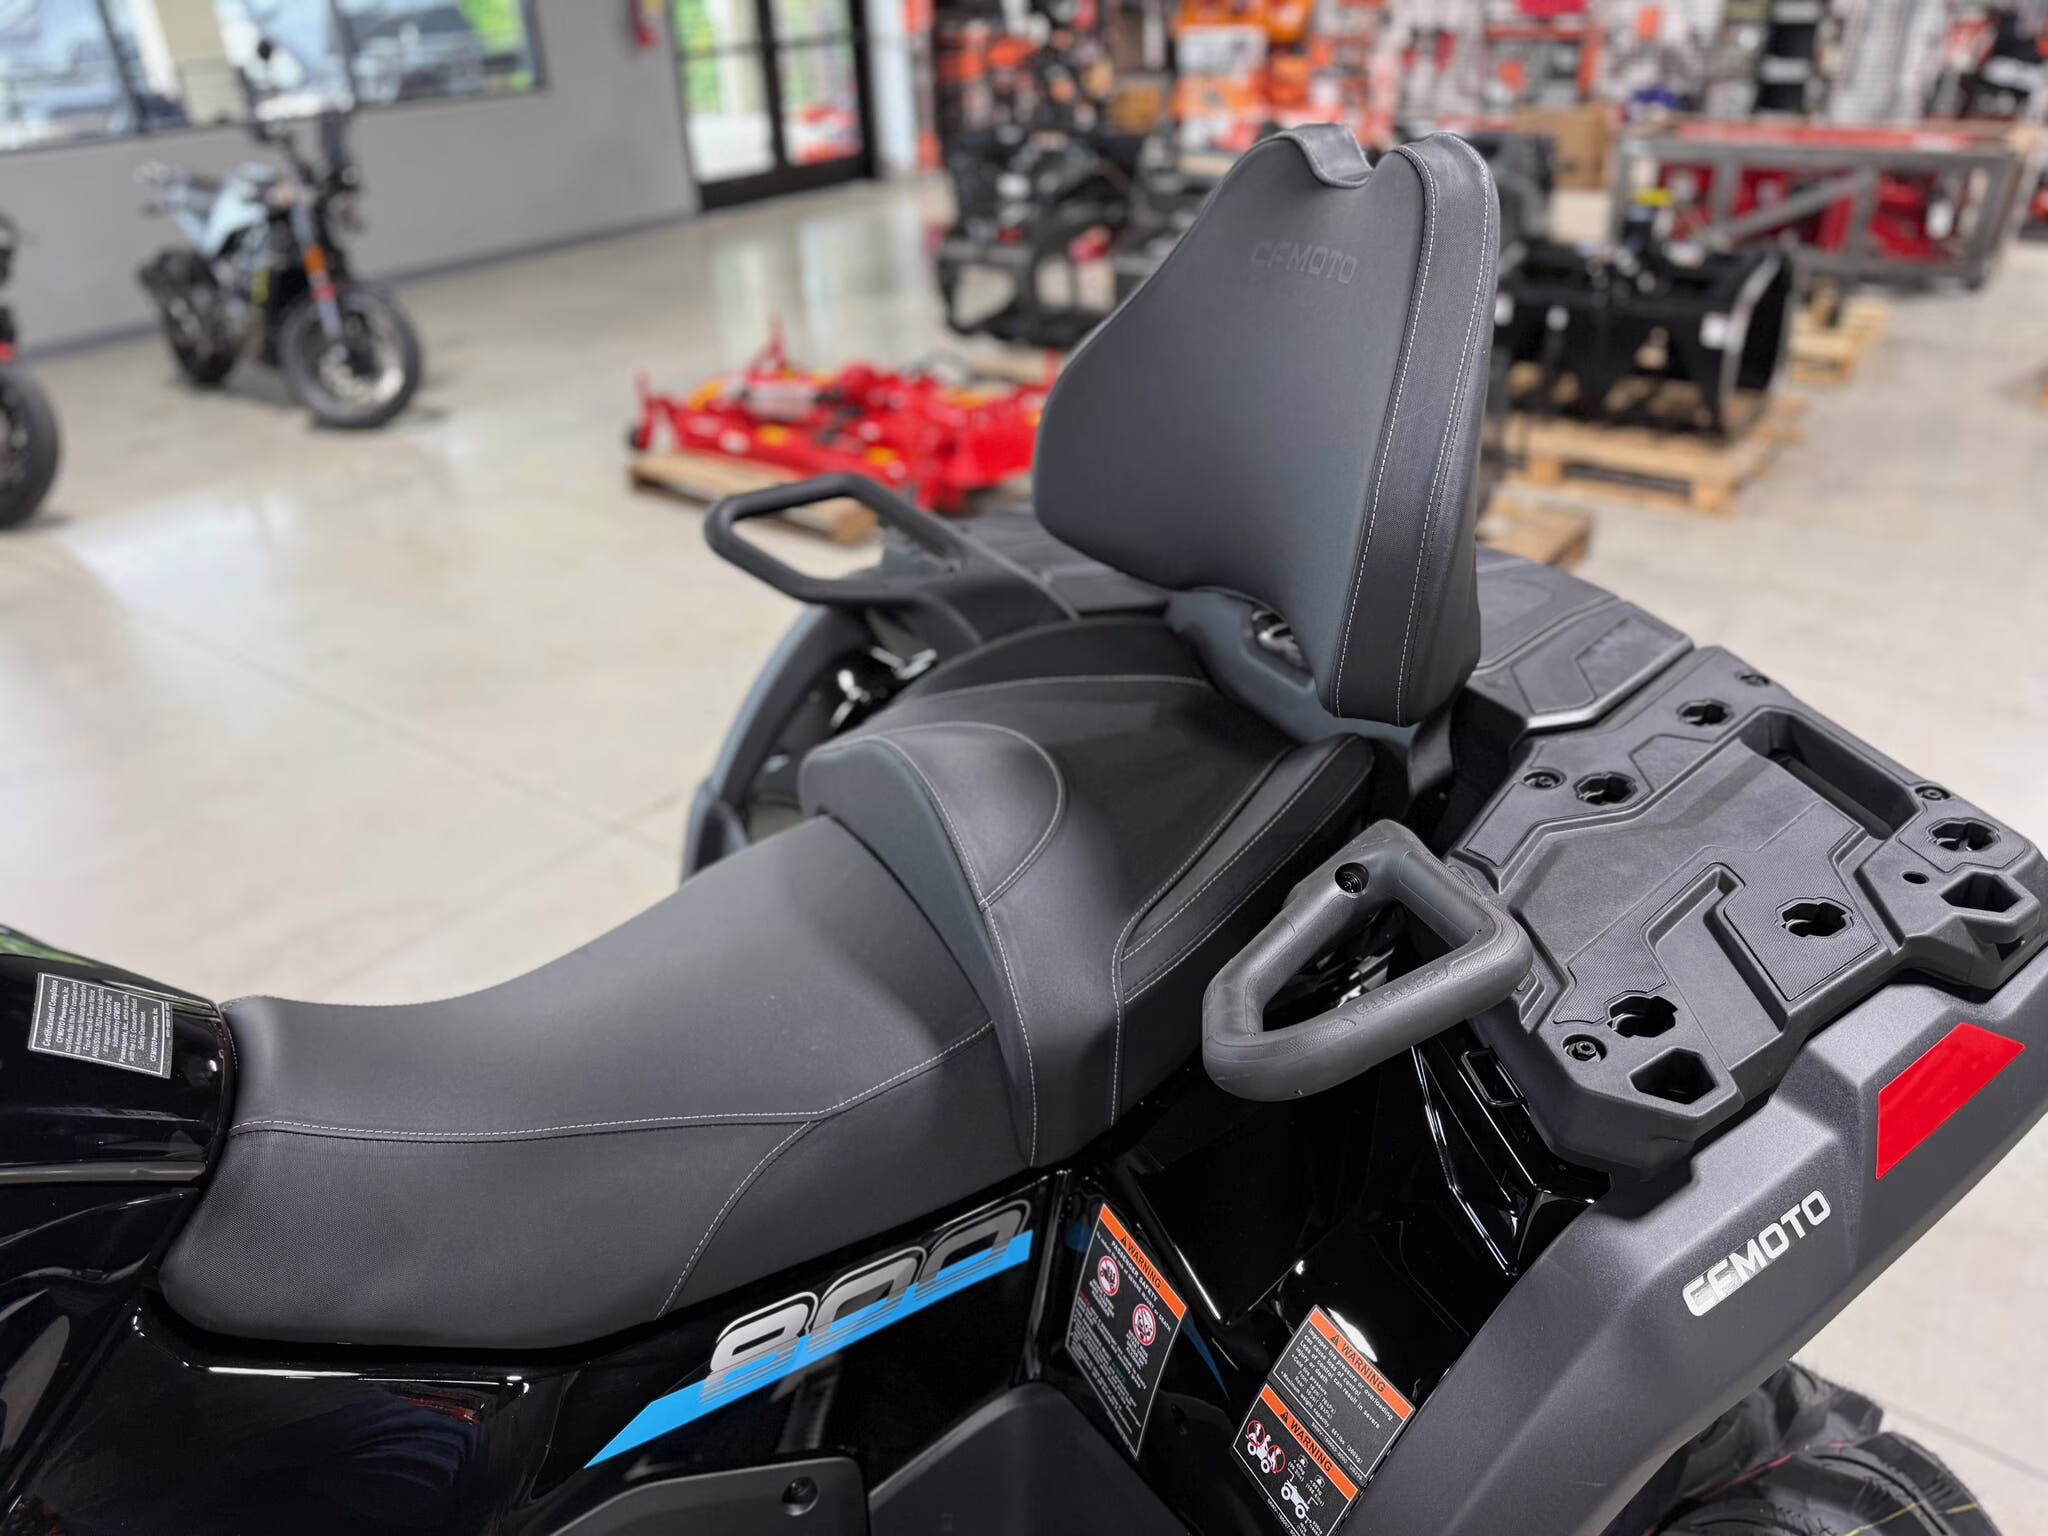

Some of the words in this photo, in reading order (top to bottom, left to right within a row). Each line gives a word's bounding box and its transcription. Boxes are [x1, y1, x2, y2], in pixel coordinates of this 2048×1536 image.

[1251, 239, 1359, 284] CFMOTO
[43, 1012, 54, 1046] Certification
[49, 980, 60, 1006] Compliance
[1112, 1240, 1138, 1278] PASSENGER
[1139, 1276, 1157, 1303] SAFETY
[1128, 1243, 1161, 1290] WARNING
[1682, 1188, 1833, 1316] CFMOTO
[1295, 1347, 1309, 1364] injury
[1304, 1335, 1313, 1345] can
[1313, 1344, 1326, 1360] cause
[1327, 1359, 1337, 1371] loss
[1337, 1370, 1343, 1378] of
[1308, 1328, 1329, 1352] Improper
[1328, 1349, 1337, 1360] tire
[1337, 1359, 1358, 1383] pressure
[1357, 1381, 1364, 1389] or
[1364, 1388, 1394, 1421] overloading
[1341, 1343, 1386, 1393] WARNING
[1300, 1341, 1311, 1354] Loss
[1311, 1353, 1317, 1361] of
[1317, 1360, 1333, 1379] control
[1333, 1378, 1342, 1389] can
[1343, 1388, 1357, 1404] result
[1357, 1403, 1363, 1411] in
[1363, 1410, 1380, 1429] severe
[1289, 1421, 1333, 1472] WARNING
